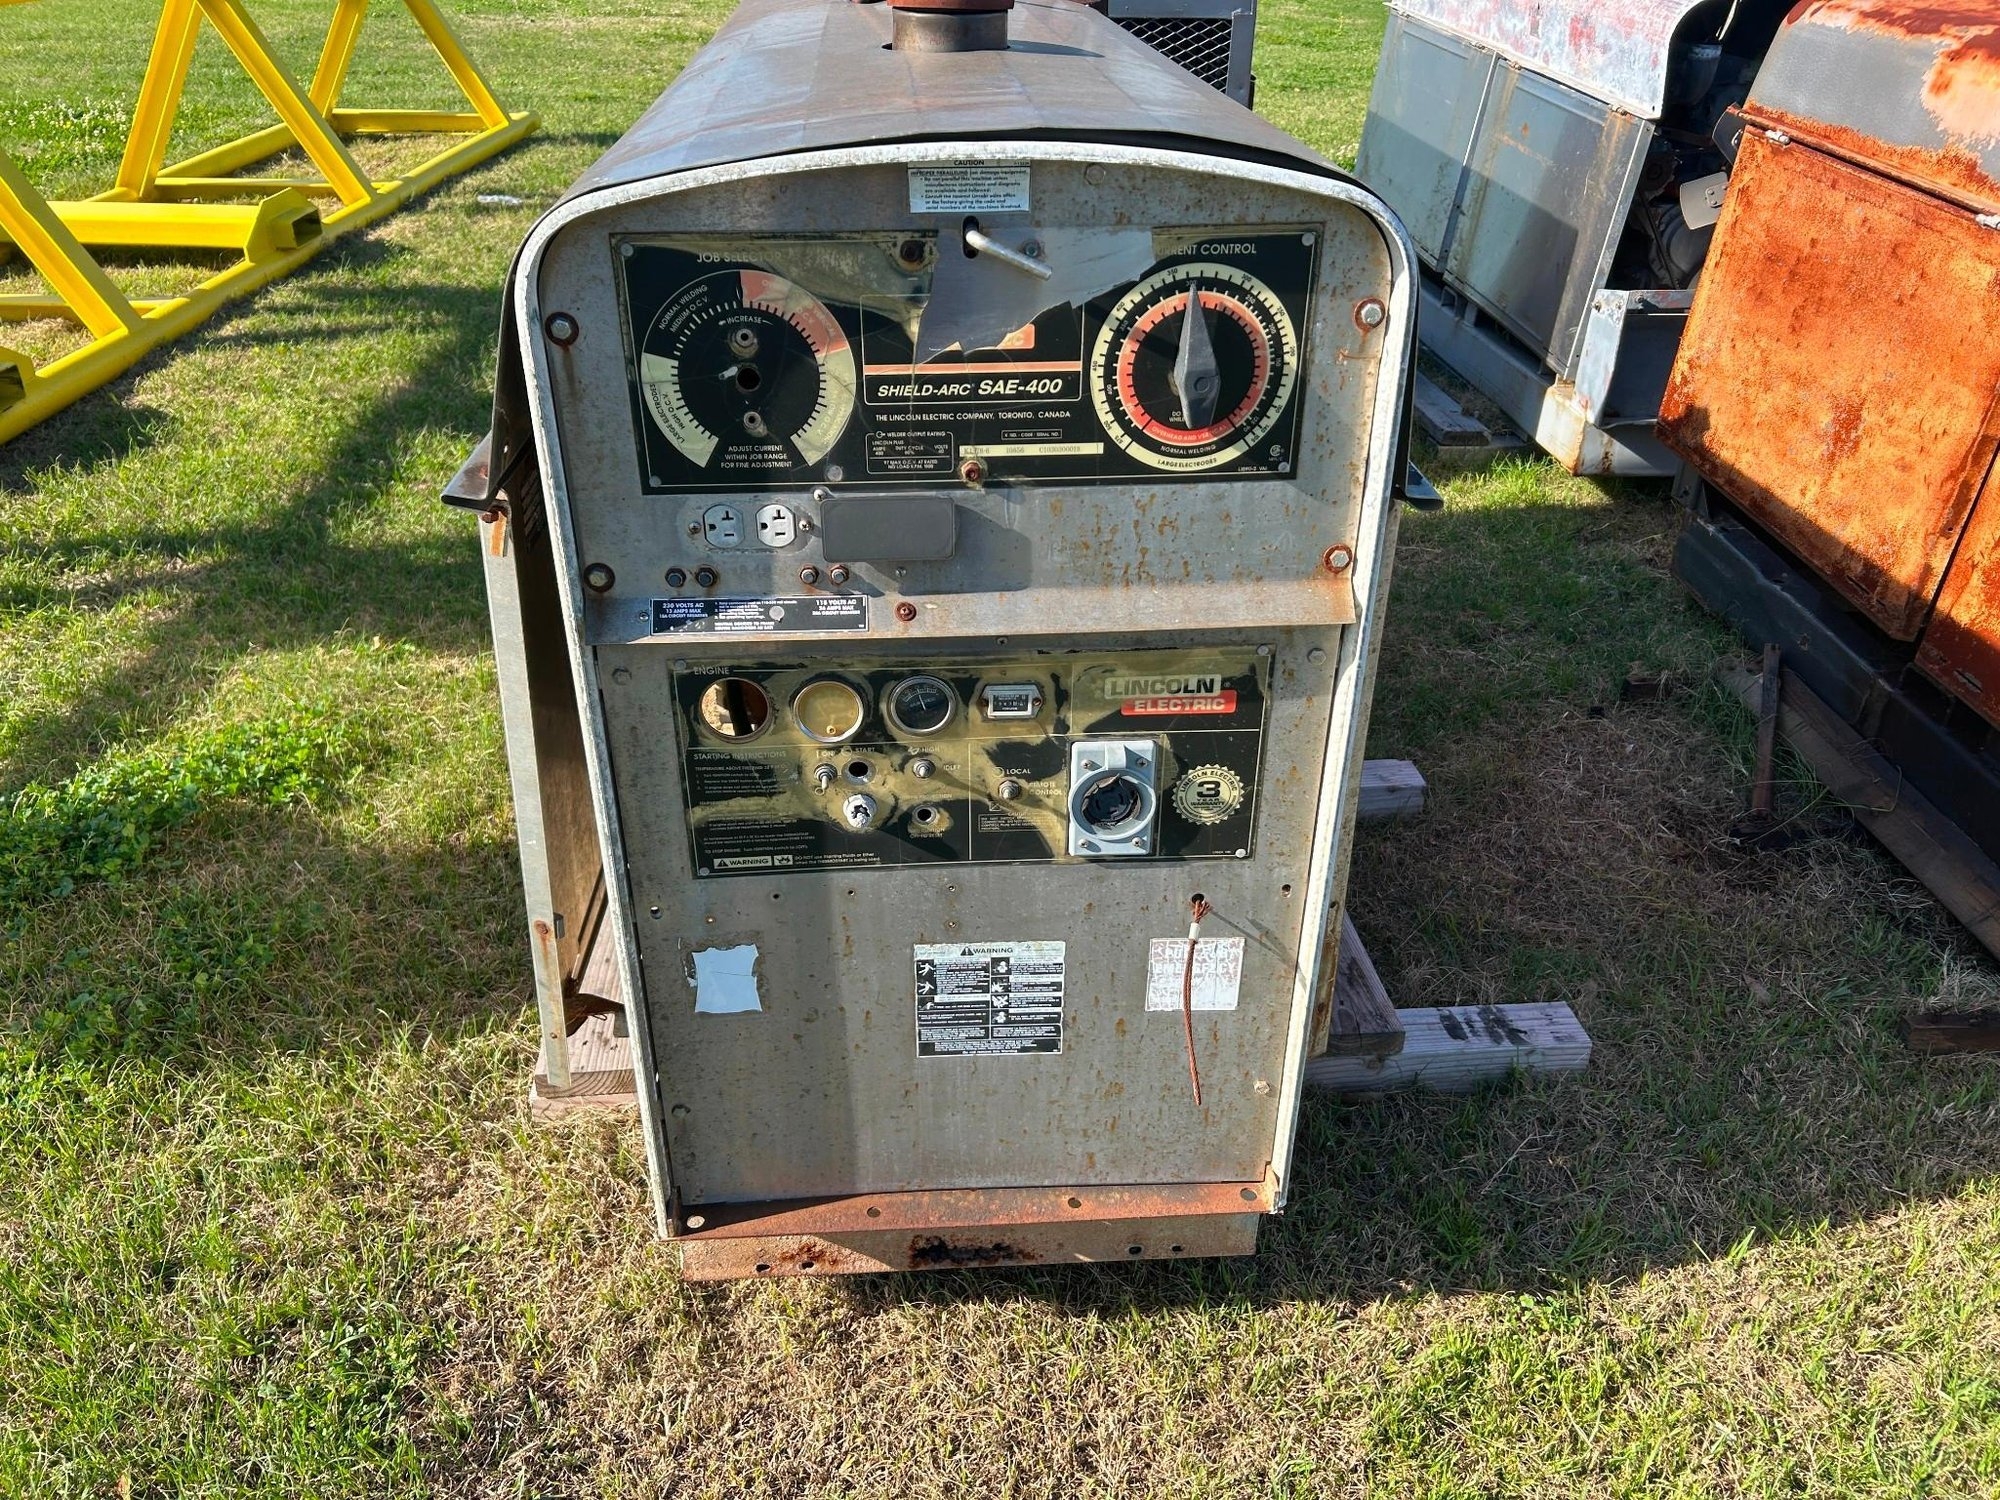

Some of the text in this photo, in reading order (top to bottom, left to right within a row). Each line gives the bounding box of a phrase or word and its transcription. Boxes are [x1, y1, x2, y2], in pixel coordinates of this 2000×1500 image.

[1157, 243, 1256, 256] URRENT CONTROL
[697, 251, 781, 263] JOB SELECTOR
[659, 285, 708, 330] NORMAL WELDING
[669, 308, 691, 332] MEDIUM
[726, 316, 762, 324] INCREASE
[877, 379, 1063, 397] SHIELD-ARC SAE-400
[650, 384, 685, 443] LARGE ELECTRODES
[957, 412, 994, 420] COMPANY,
[672, 414, 685, 429] HIGH
[1152, 427, 1182, 440] OVERHEAD
[1160, 444, 1216, 455] NORMAL WELDING
[1157, 458, 1217, 467] LARGE ELECTRODES
[693, 666, 730, 675] ENGINE
[1110, 678, 1214, 696] LINCOLN
[1134, 698, 1225, 712] ELECTRIC
[732, 751, 786, 759] INSTRUCTIONS
[1180, 770, 1238, 792] LINCOLN ELECTRIC
[1197, 781, 1221, 797] 3
